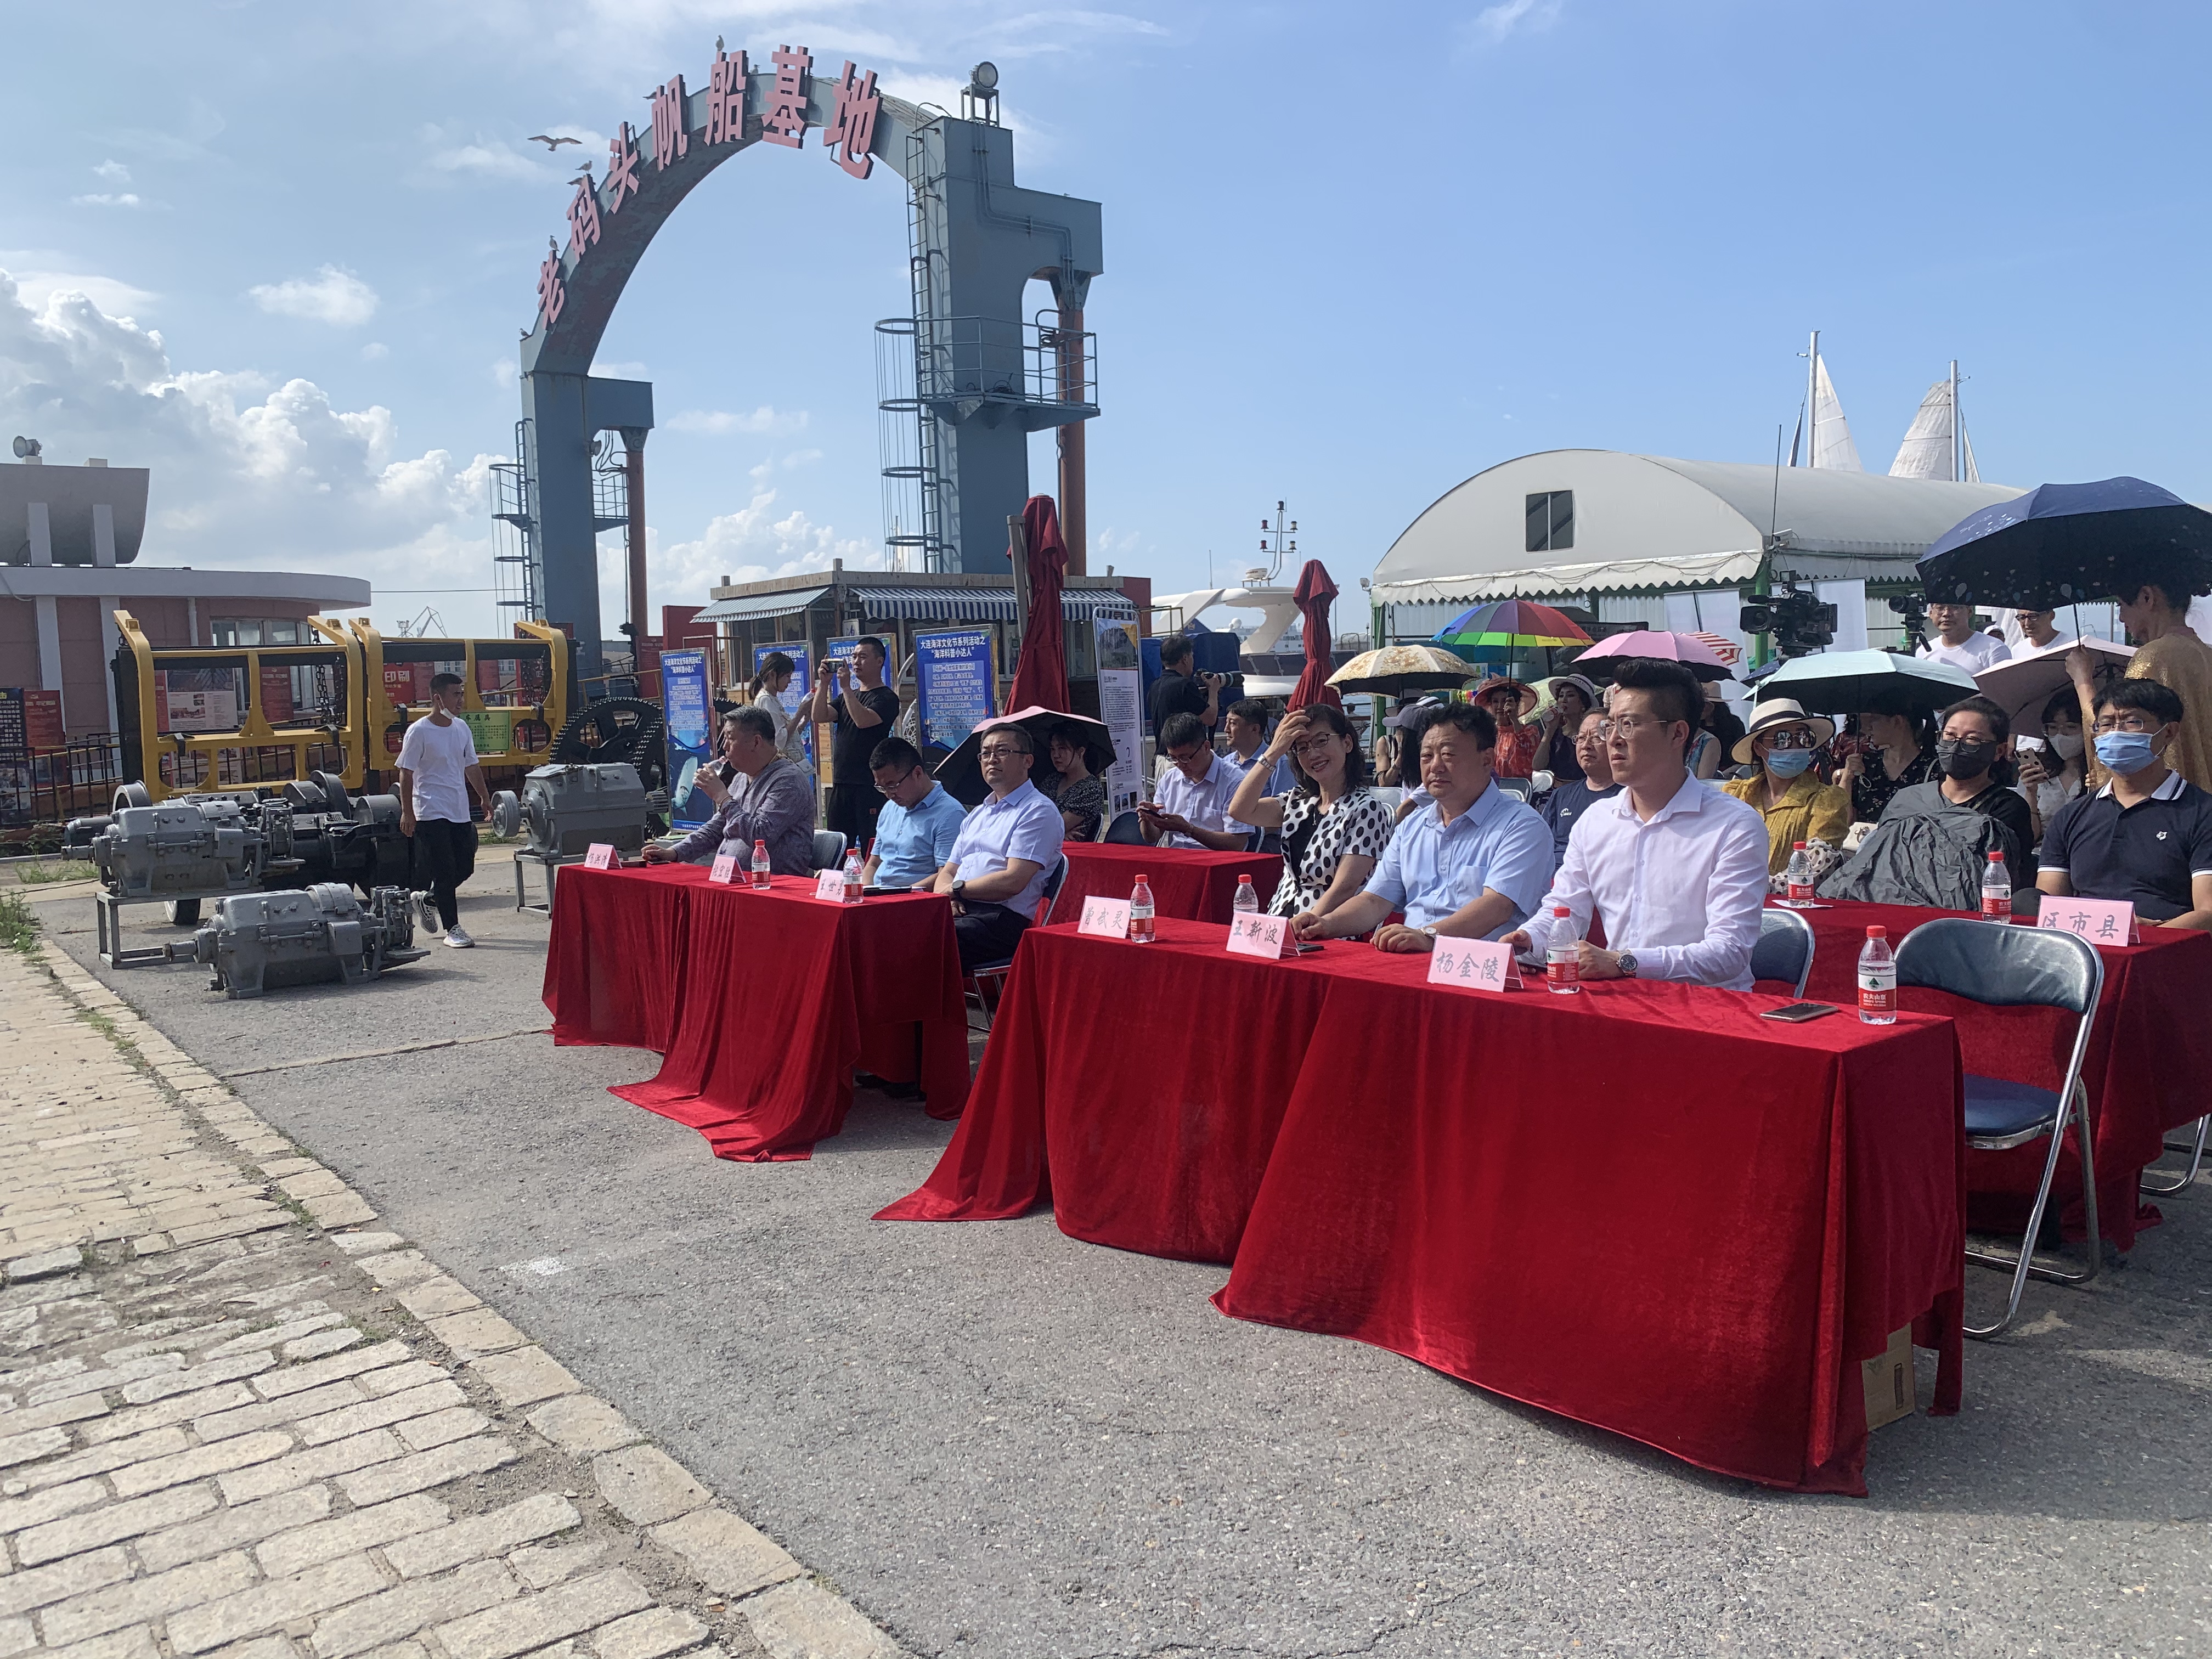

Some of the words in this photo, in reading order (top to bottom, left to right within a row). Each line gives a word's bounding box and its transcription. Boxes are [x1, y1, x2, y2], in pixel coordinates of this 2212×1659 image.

[537, 44, 882, 331] 老码头帆船基地
[920, 636, 986, 650] 大连海洋文化节系列活动之
[385, 670, 410, 682] 印刷
[1085, 906, 1124, 930] 曾武灵
[2042, 911, 2119, 939] 区市县
[1233, 919, 1278, 945] 王新波
[1435, 950, 1500, 983] 杨金陵
